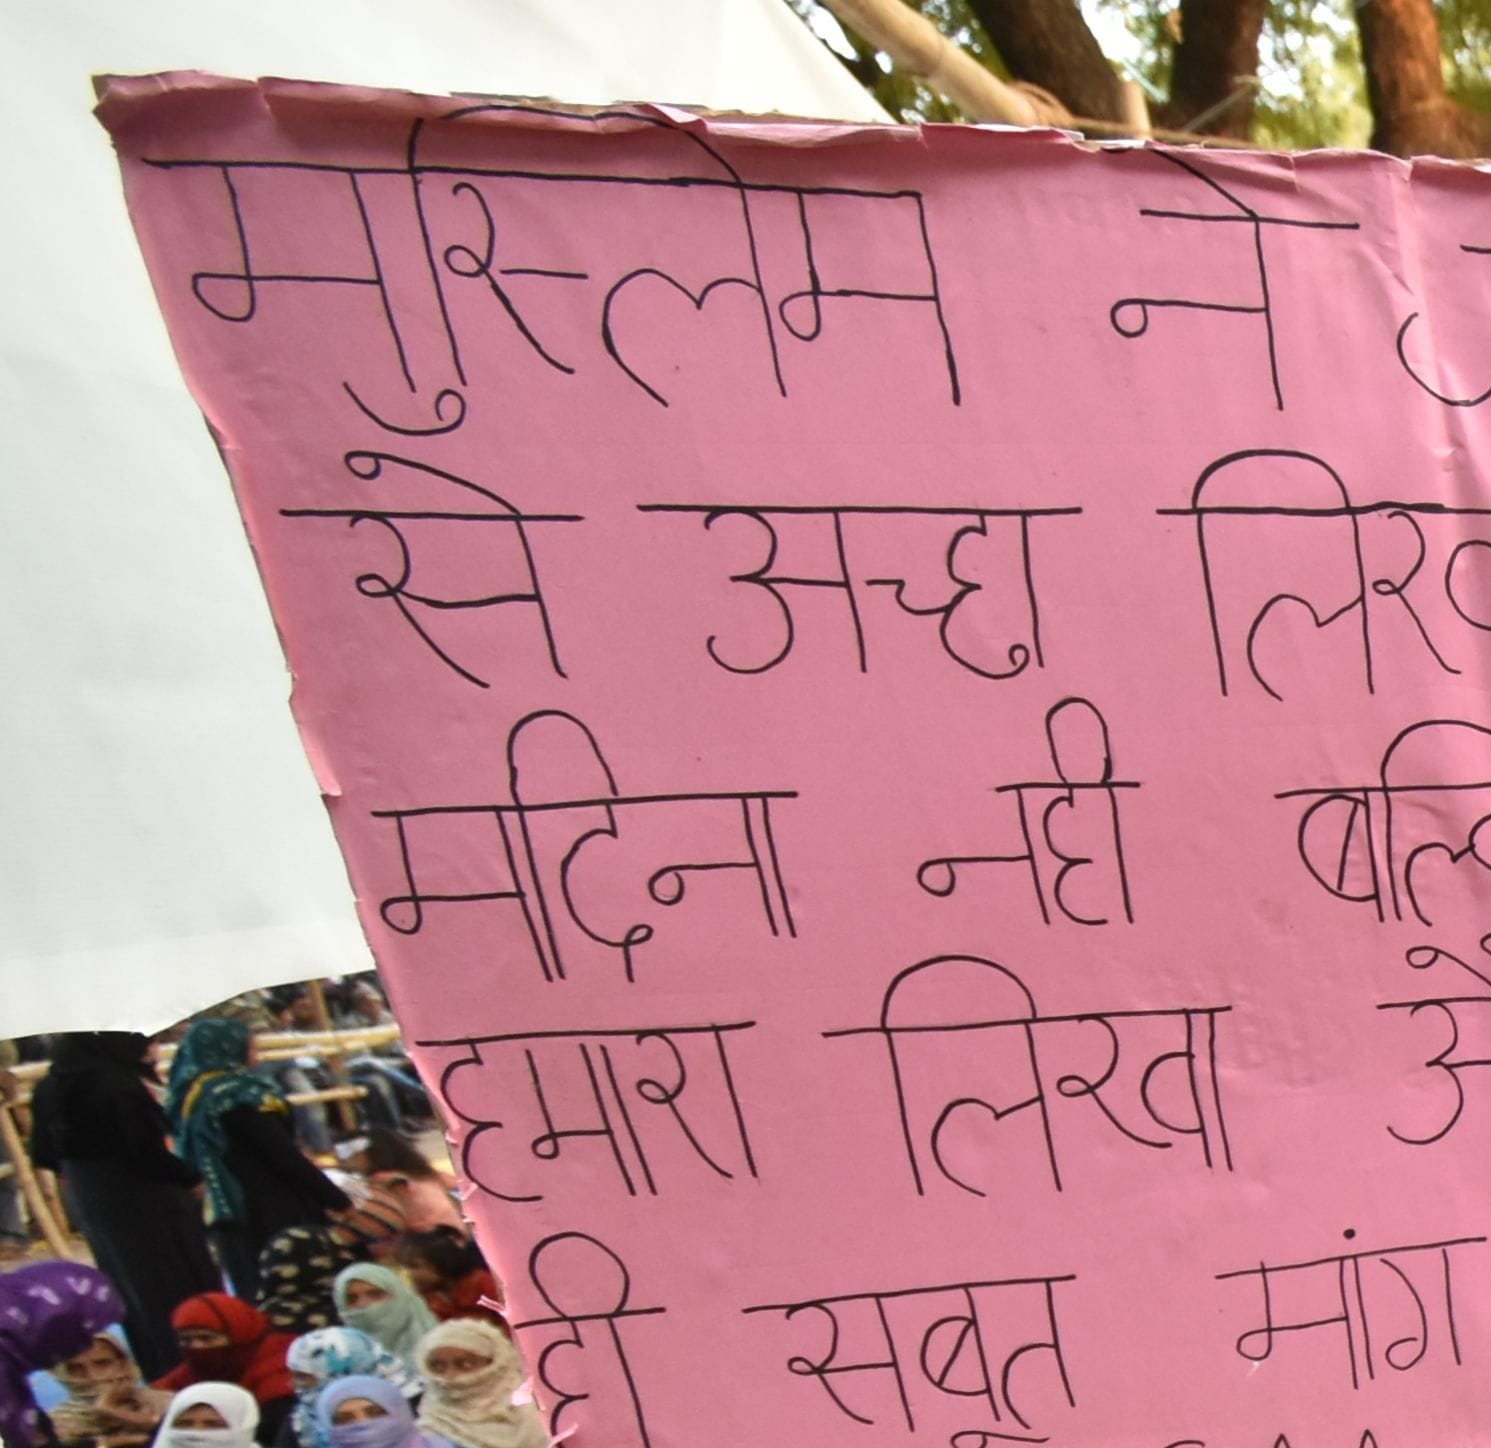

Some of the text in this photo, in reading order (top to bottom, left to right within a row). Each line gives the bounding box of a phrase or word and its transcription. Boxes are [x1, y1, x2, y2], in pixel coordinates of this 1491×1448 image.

[1110, 145, 1360, 411] ने
[279, 451, 585, 689] से
[415, 1020, 758, 1201] हमारा
[822, 955, 1232, 1197] लिखा
